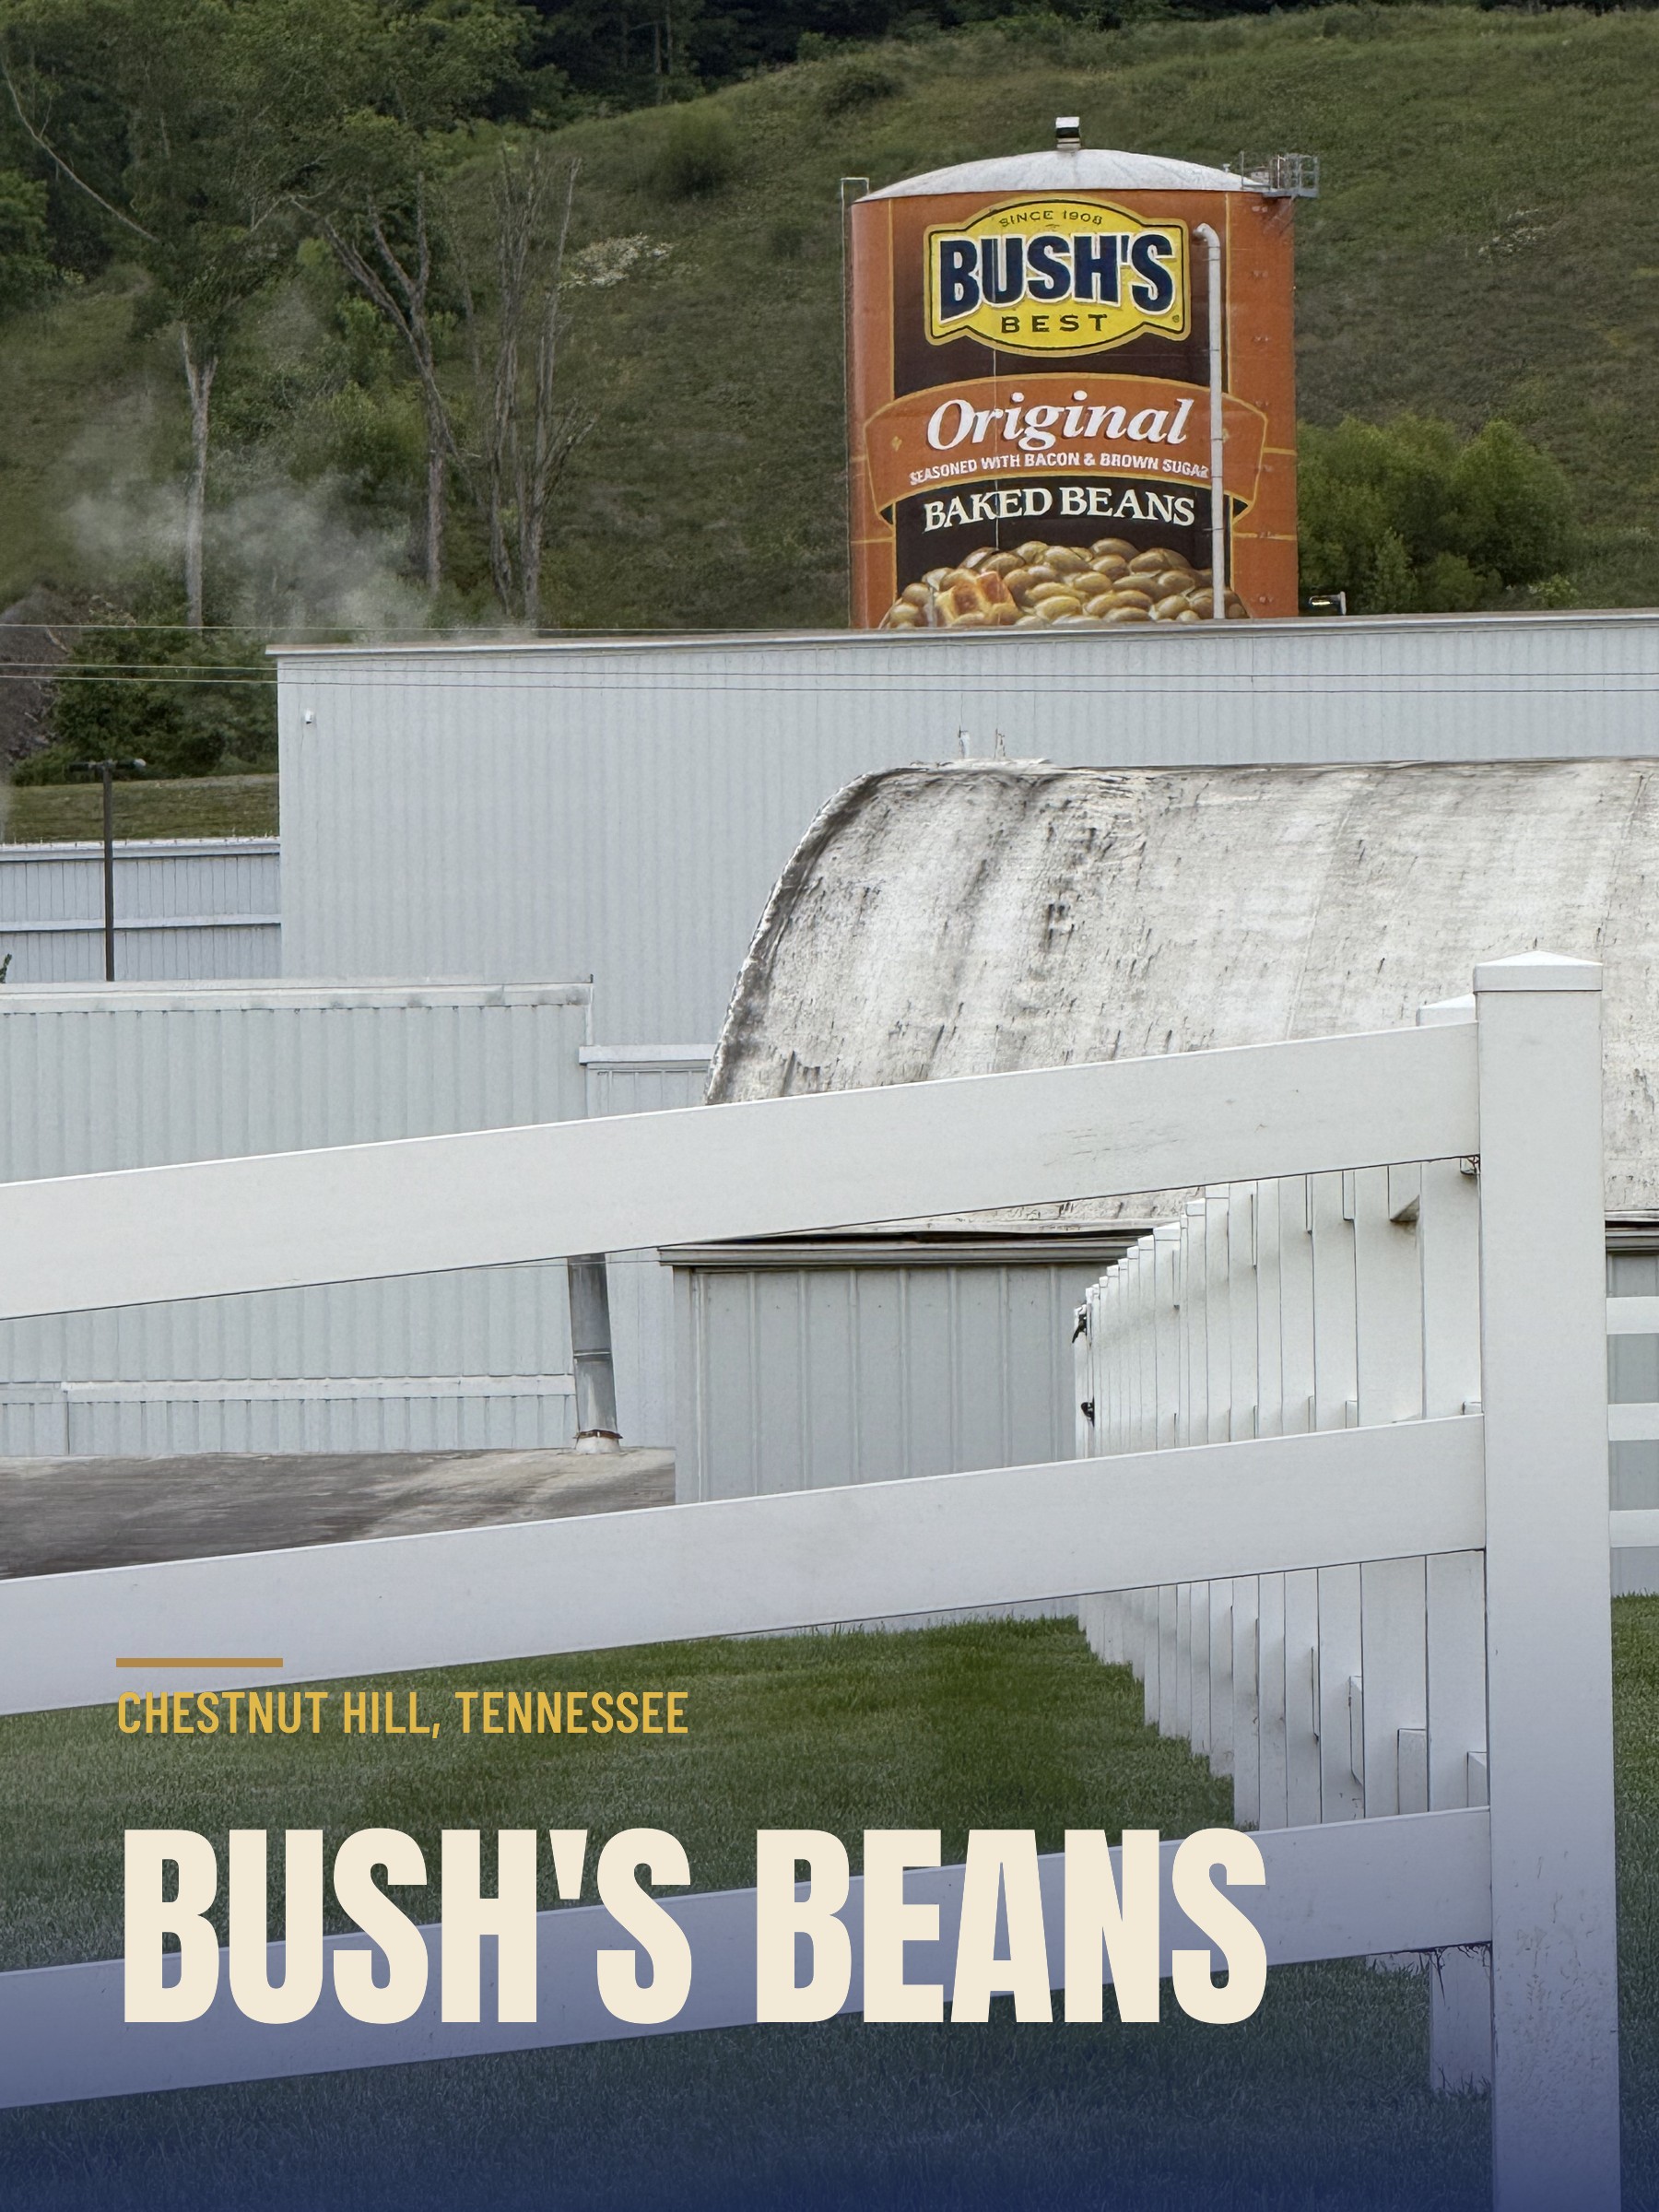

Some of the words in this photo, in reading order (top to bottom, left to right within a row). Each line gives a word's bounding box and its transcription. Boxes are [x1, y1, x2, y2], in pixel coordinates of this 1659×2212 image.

[998, 209, 1054, 228] SINCE
[1062, 209, 1103, 226] 1908
[938, 230, 1177, 327] BUSH'S
[1001, 313, 1108, 334] BEST
[926, 389, 1194, 452] Original
[909, 459, 978, 486] SEASONED
[981, 454, 1021, 470] WITH
[1024, 453, 1080, 468] BACON
[1083, 453, 1096, 467] &
[1100, 452, 1159, 471] BROWN
[1162, 458, 1209, 478] SUGAR
[924, 487, 1053, 534] BAKED
[1059, 486, 1195, 527] BEANS
